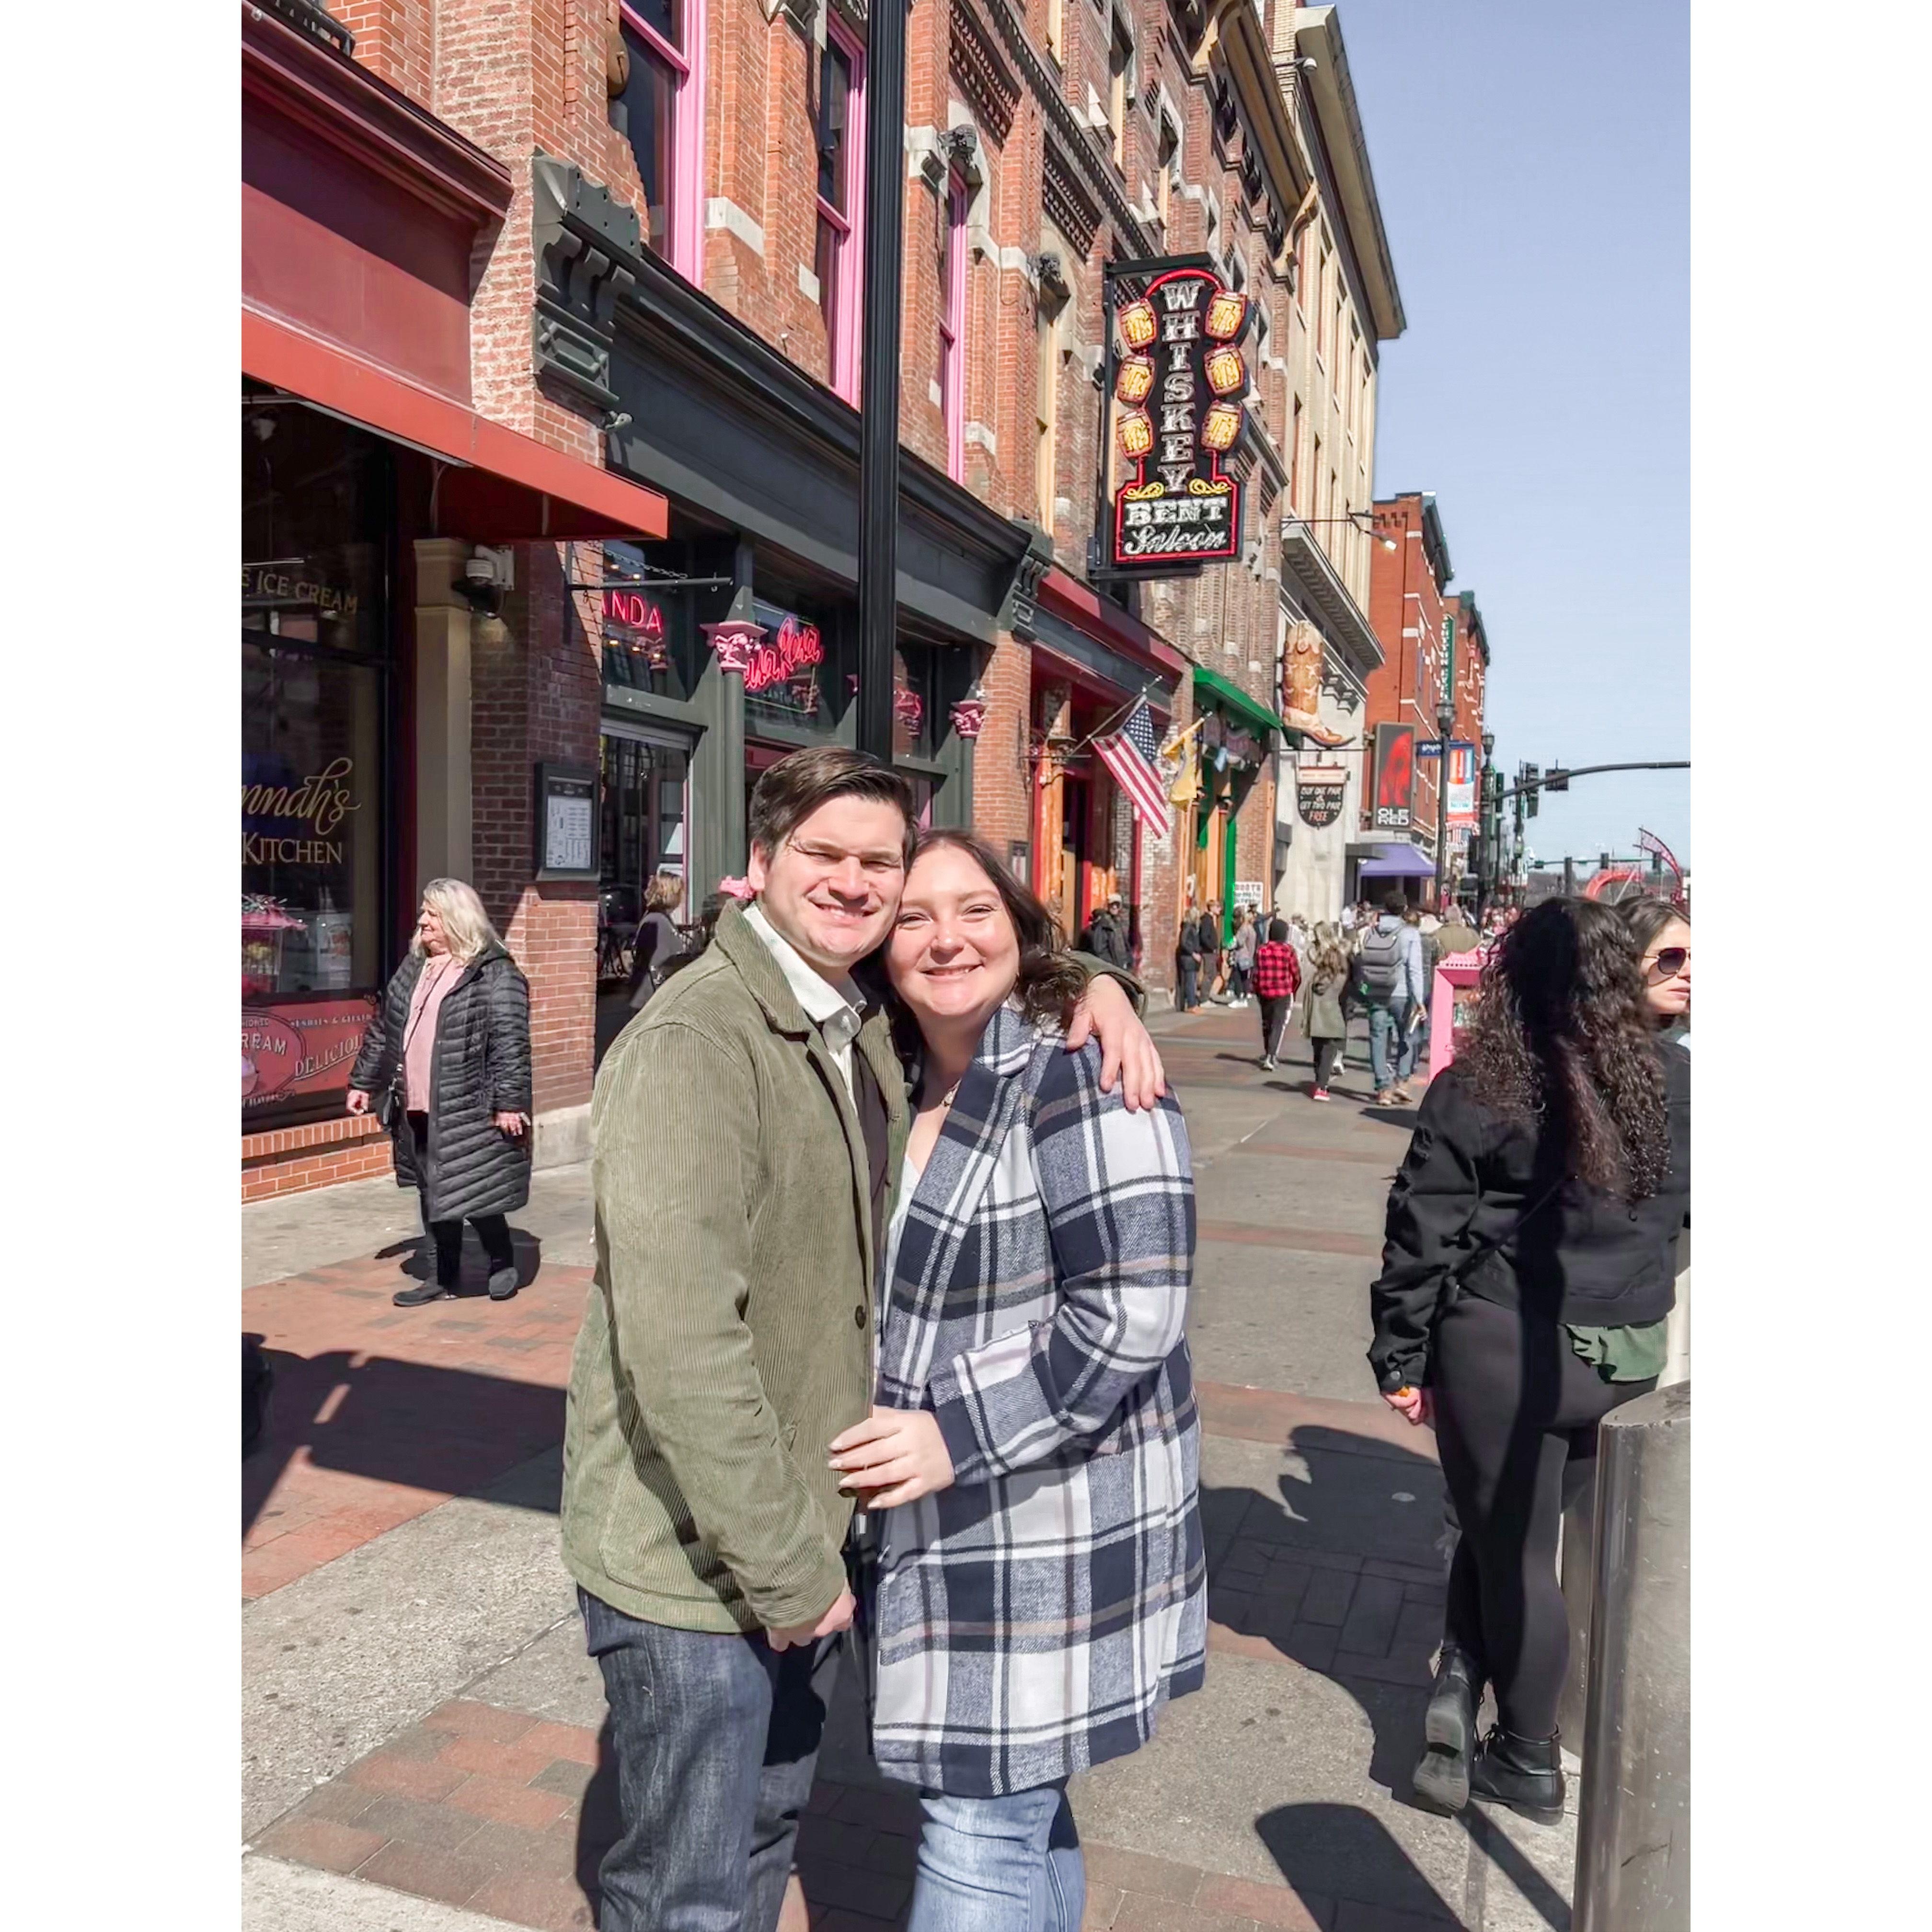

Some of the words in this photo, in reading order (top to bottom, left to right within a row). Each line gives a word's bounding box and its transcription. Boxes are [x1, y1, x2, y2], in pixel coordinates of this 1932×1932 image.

[1158, 283, 1204, 493] WHISKEY
[1125, 498, 1228, 526] BENT
[1125, 523, 1227, 554] Saloon
[256, 570, 289, 597] ICE
[295, 581, 358, 615] CREAM
[1378, 808, 1409, 816] OLE
[1378, 816, 1409, 826] RED
[242, 832, 342, 864] KITCHEN
[242, 1032, 287, 1055] REAM
[295, 1033, 364, 1077] DELICIOU
